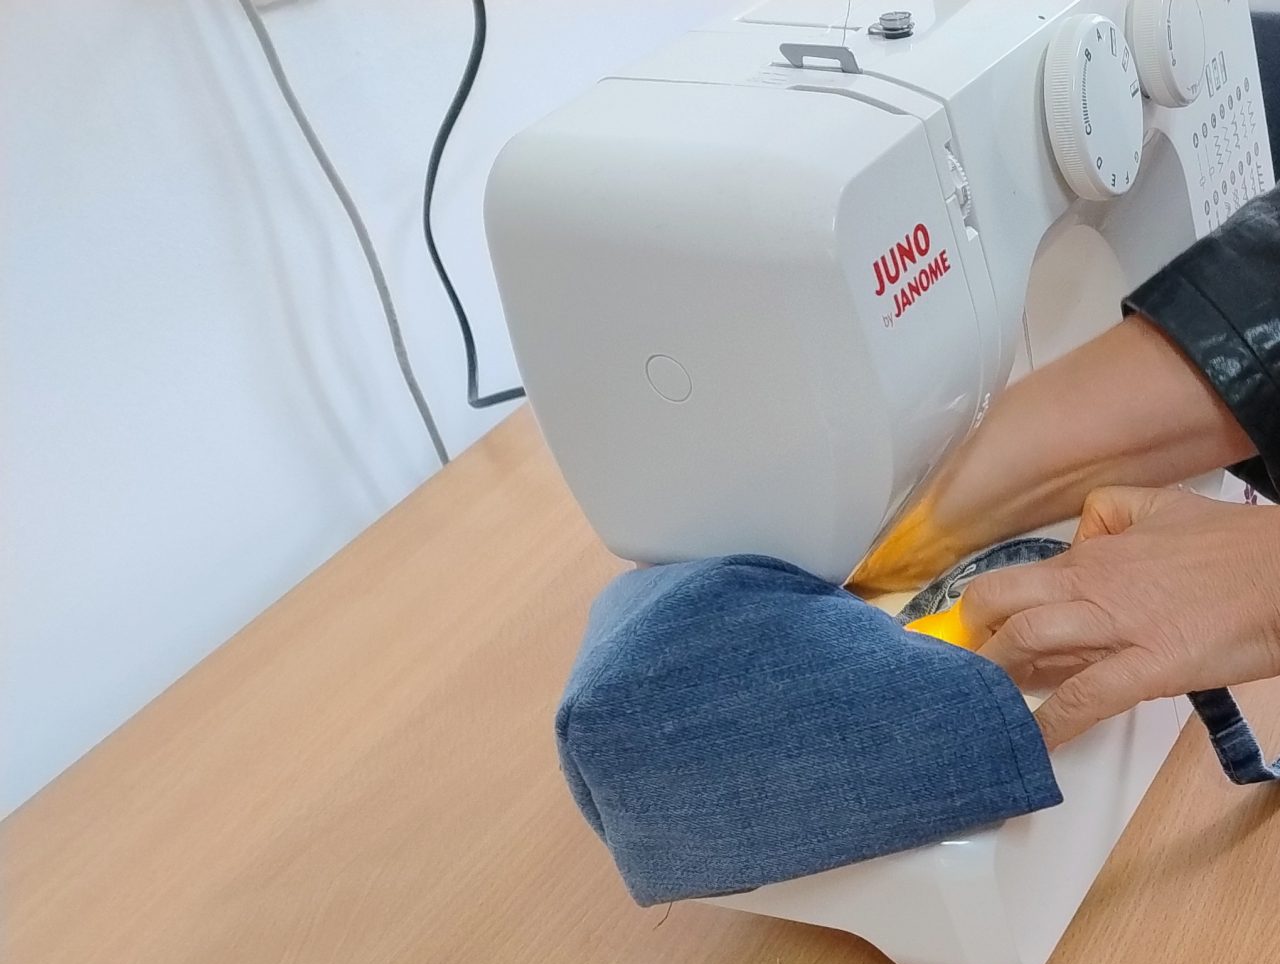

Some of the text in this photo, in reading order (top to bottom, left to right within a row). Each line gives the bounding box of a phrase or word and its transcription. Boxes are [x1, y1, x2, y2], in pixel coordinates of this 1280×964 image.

[1084, 47, 1092, 62] B
[1084, 122, 1092, 136] C
[1111, 173, 1117, 188] E
[873, 223, 930, 296] JUNO
[882, 249, 951, 328] by JANOME
